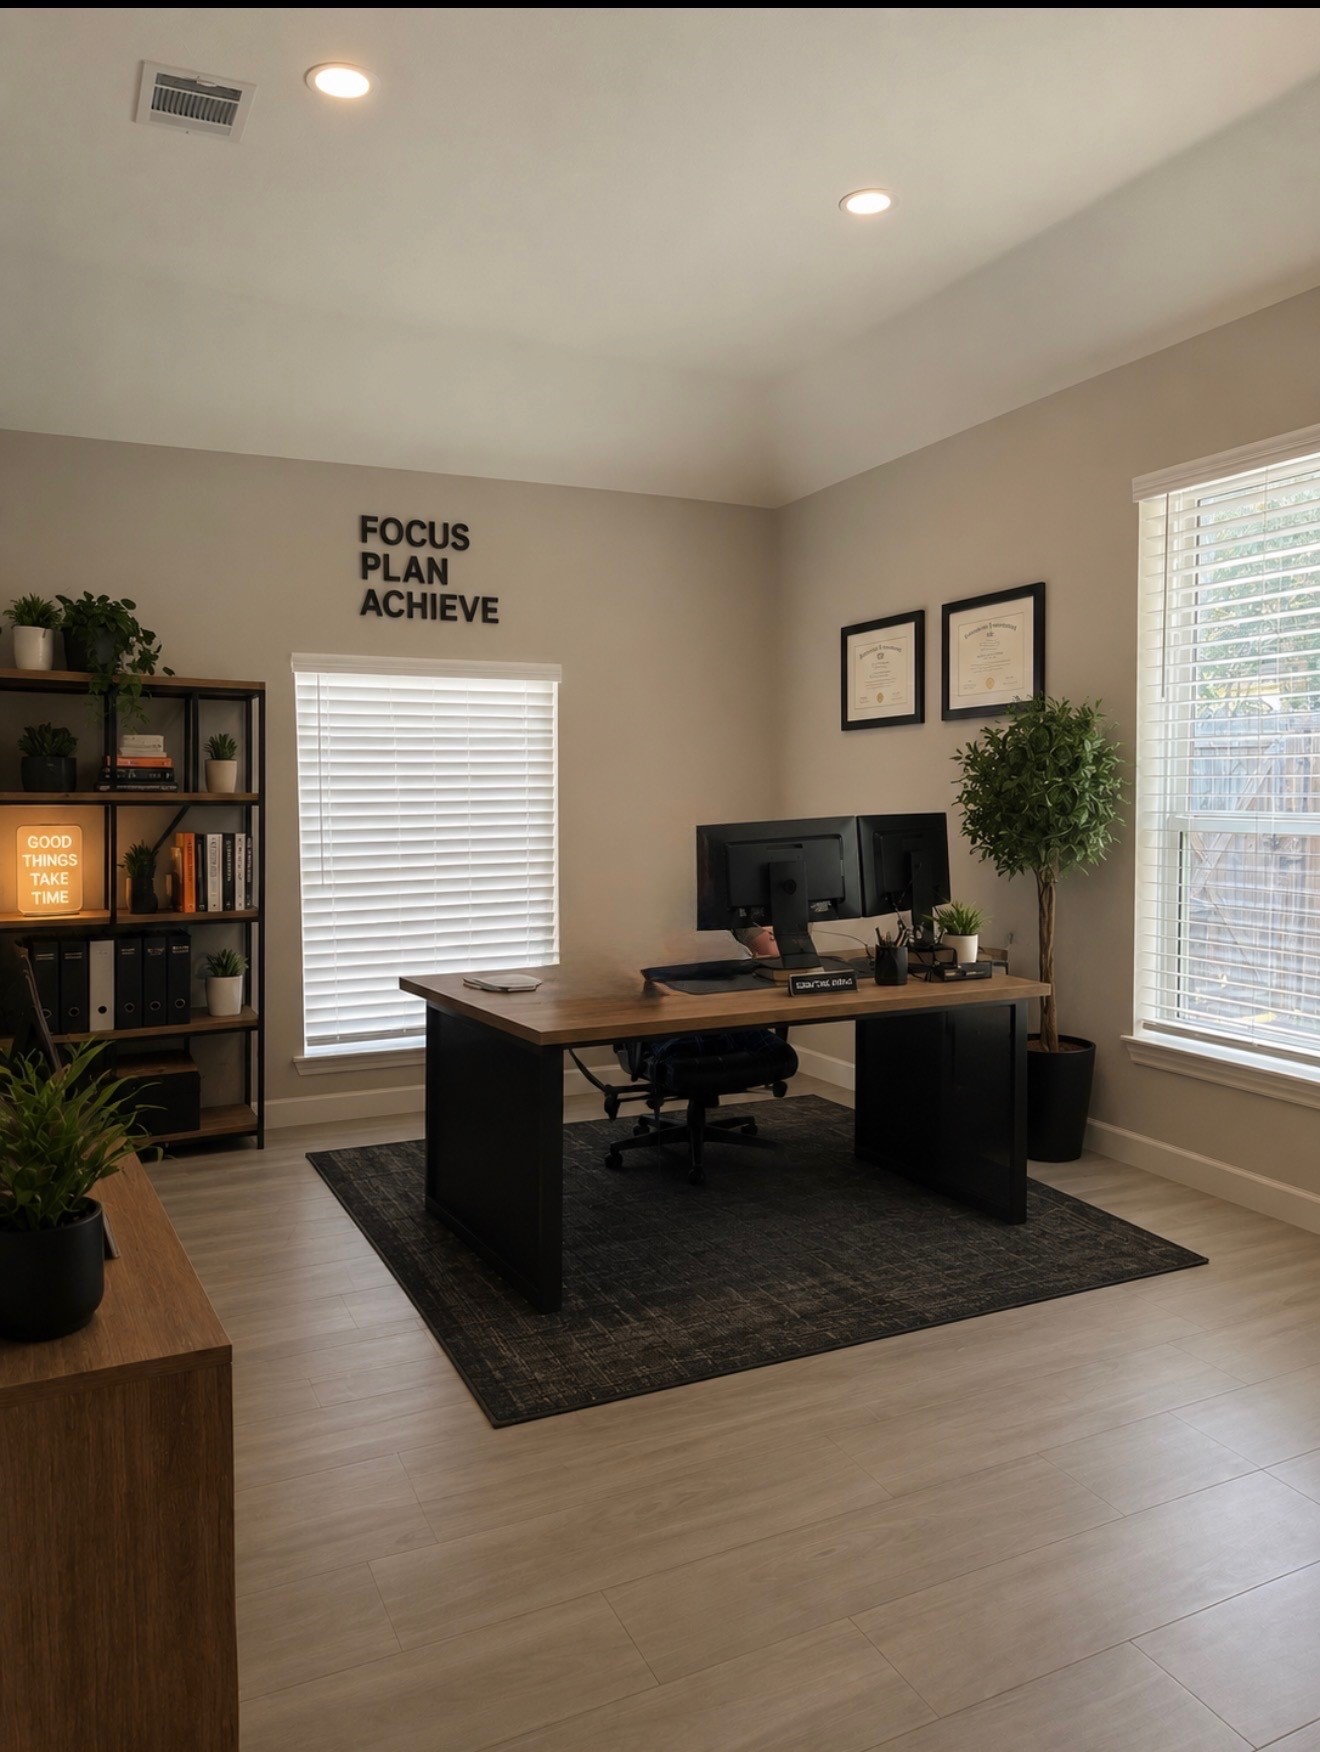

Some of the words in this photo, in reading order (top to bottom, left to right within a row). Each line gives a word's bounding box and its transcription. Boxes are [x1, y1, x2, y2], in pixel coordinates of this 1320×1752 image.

[360, 514, 470, 551] FOCUS
[361, 552, 448, 585] PLAN
[360, 588, 499, 624] ACHIEVE
[27, 835, 73, 849] GOOD
[22, 853, 78, 867] THINGS
[30, 871, 69, 886] TAKE
[31, 890, 70, 905] TIME
